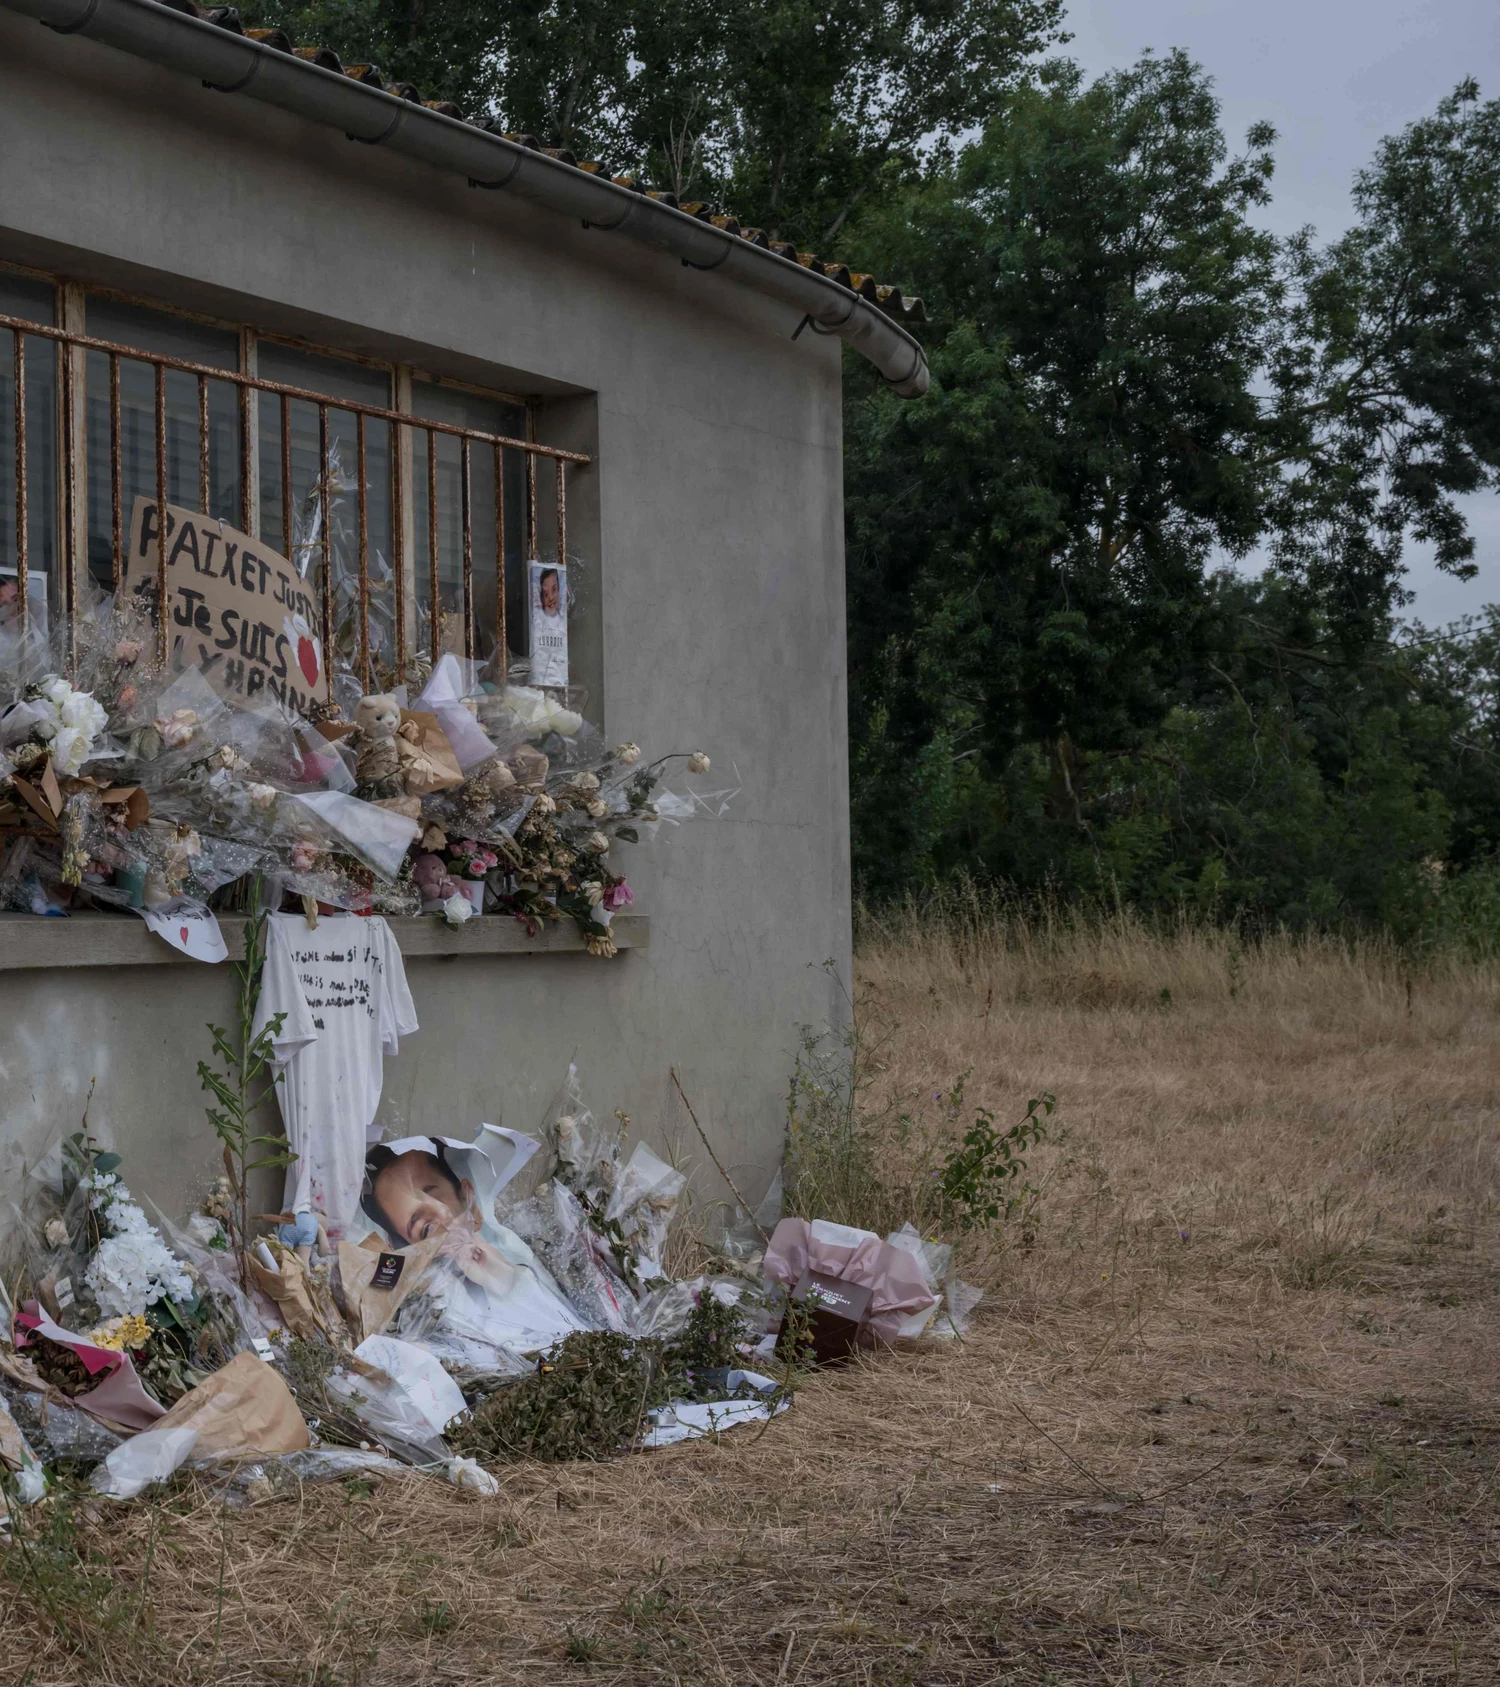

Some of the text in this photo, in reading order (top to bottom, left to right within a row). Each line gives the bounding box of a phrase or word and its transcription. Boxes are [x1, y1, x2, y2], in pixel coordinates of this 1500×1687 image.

[139, 504, 236, 586] PAIX
[241, 551, 272, 595] ET
[215, 609, 290, 678] SUIS
